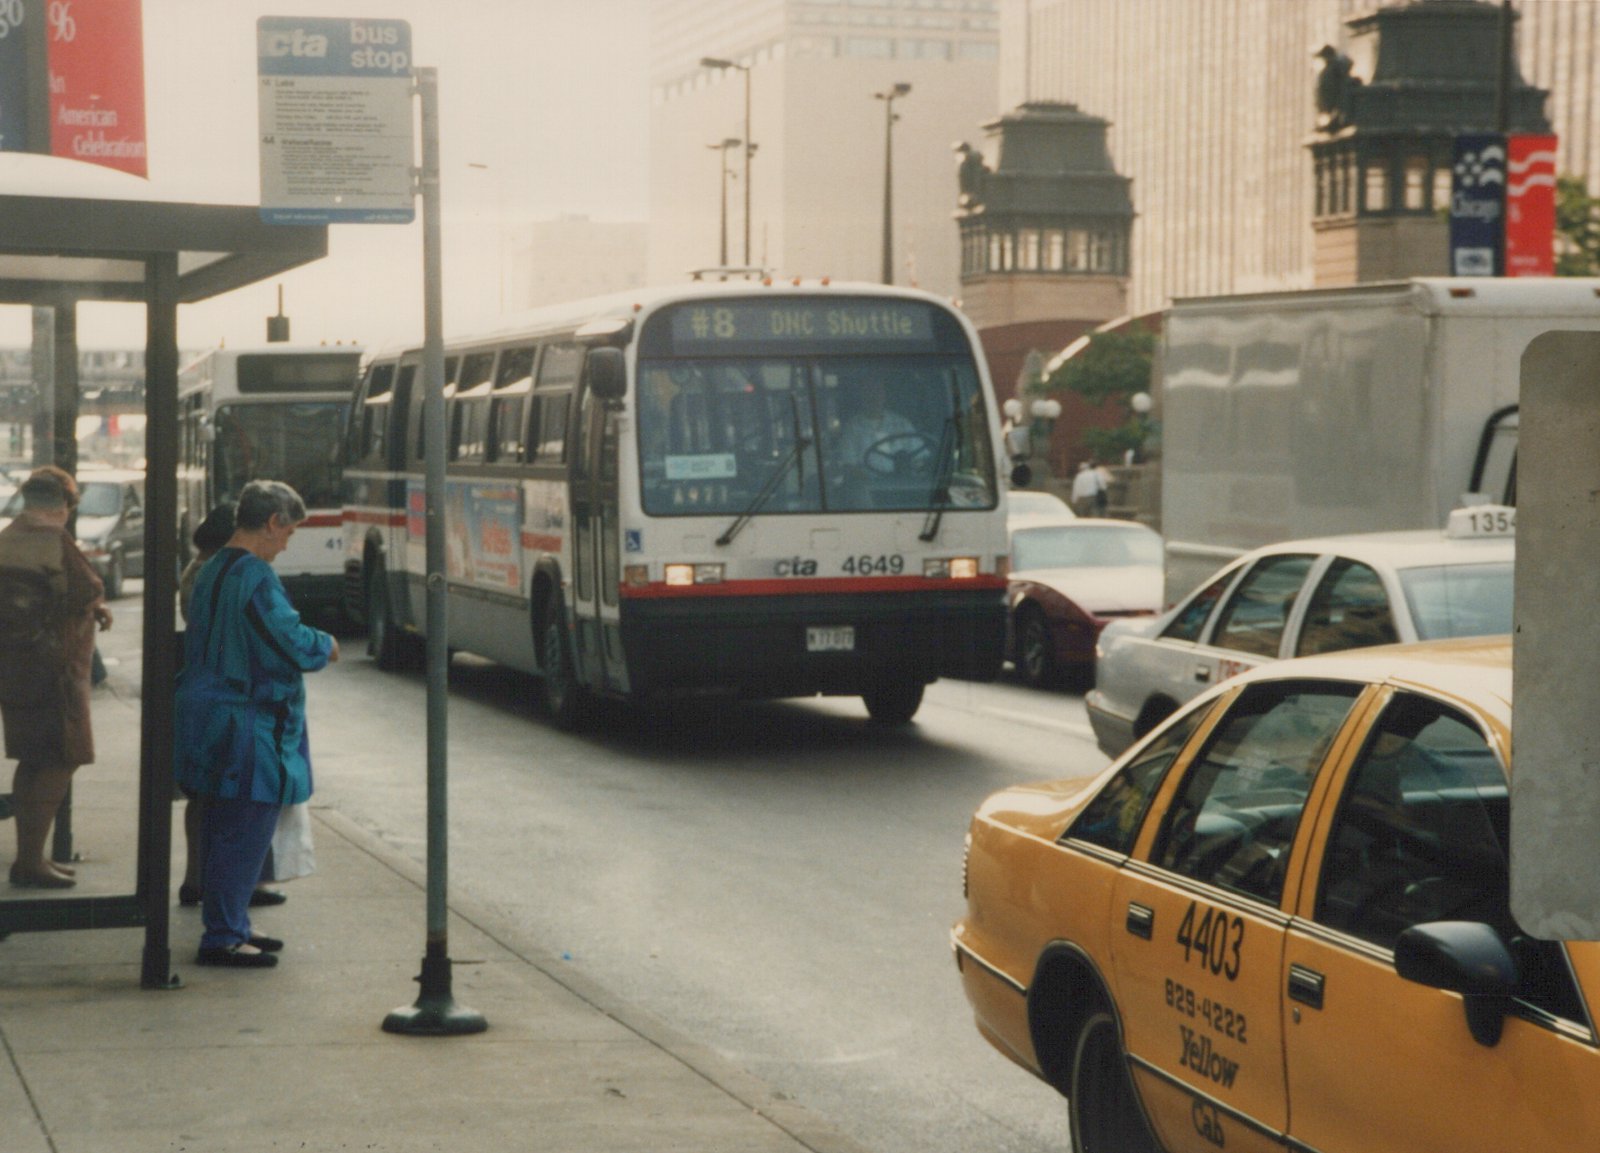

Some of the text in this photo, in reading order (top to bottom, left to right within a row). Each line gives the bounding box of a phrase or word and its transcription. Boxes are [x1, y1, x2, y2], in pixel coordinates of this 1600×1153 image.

[267, 28, 328, 58] cta
[351, 20, 398, 45] bus
[351, 47, 408, 73] stop
[58, 103, 117, 126] American
[73, 130, 145, 157] Celebration
[690, 307, 735, 338] #8
[826, 309, 912, 335] Shuttle
[773, 554, 905, 576] cta 4649
[1176, 900, 1245, 982] 4403
[1165, 977, 1248, 1044] 829-4222
[1179, 1024, 1240, 1090] Yellow
[1191, 1098, 1225, 1149] Cab
